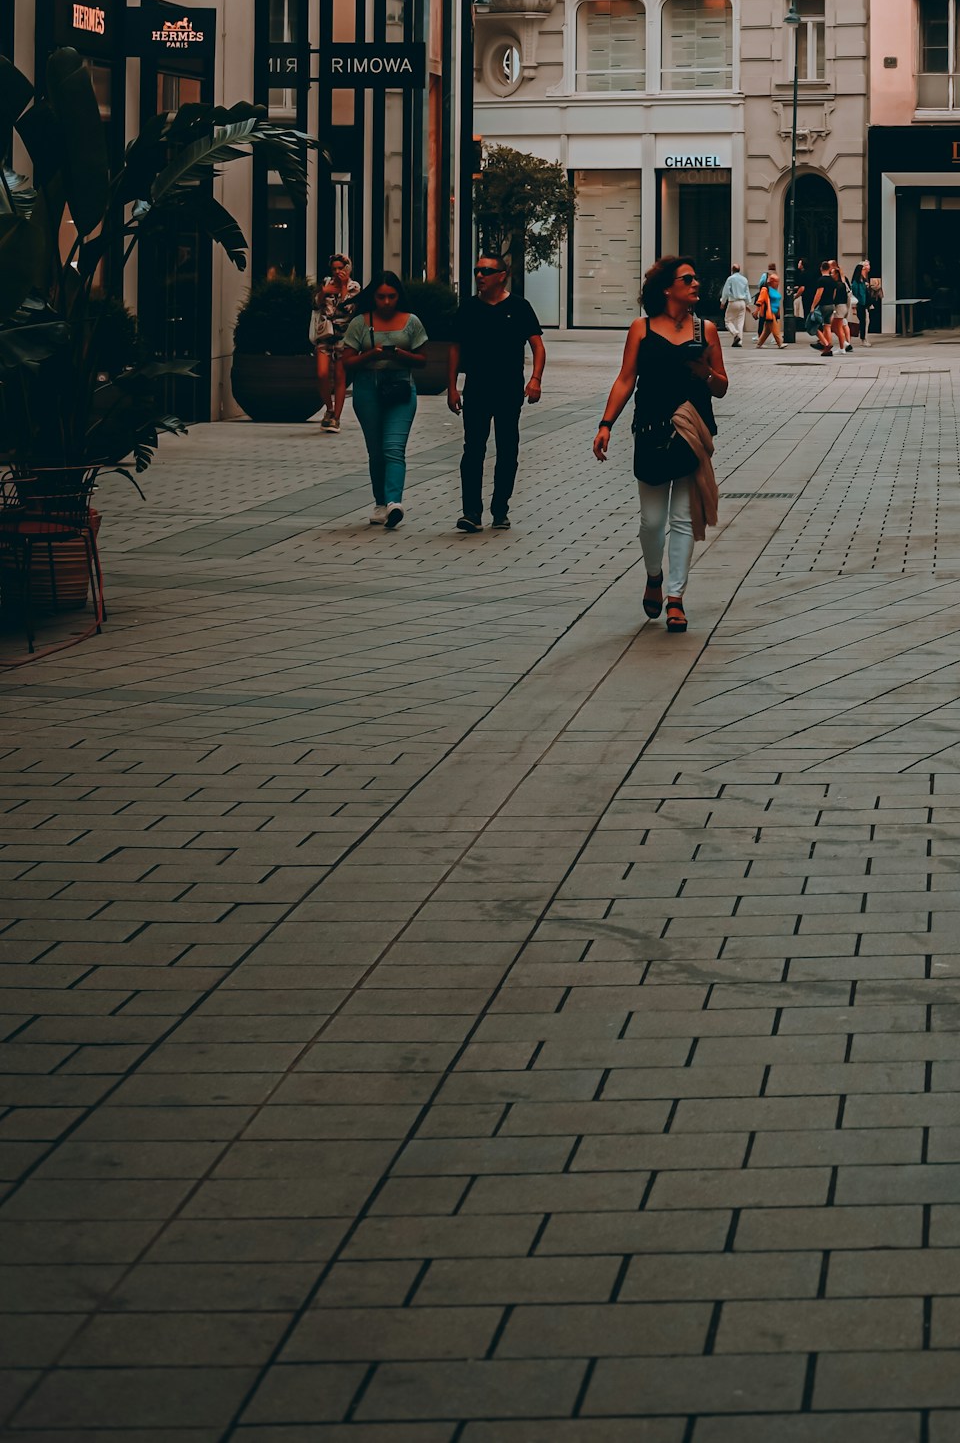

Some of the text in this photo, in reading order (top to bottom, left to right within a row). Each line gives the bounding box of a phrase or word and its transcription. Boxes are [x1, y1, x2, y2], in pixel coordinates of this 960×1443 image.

[165, 41, 189, 49] PARIS
[331, 58, 413, 73] RIMOWA
[665, 156, 721, 167] CHANEL
